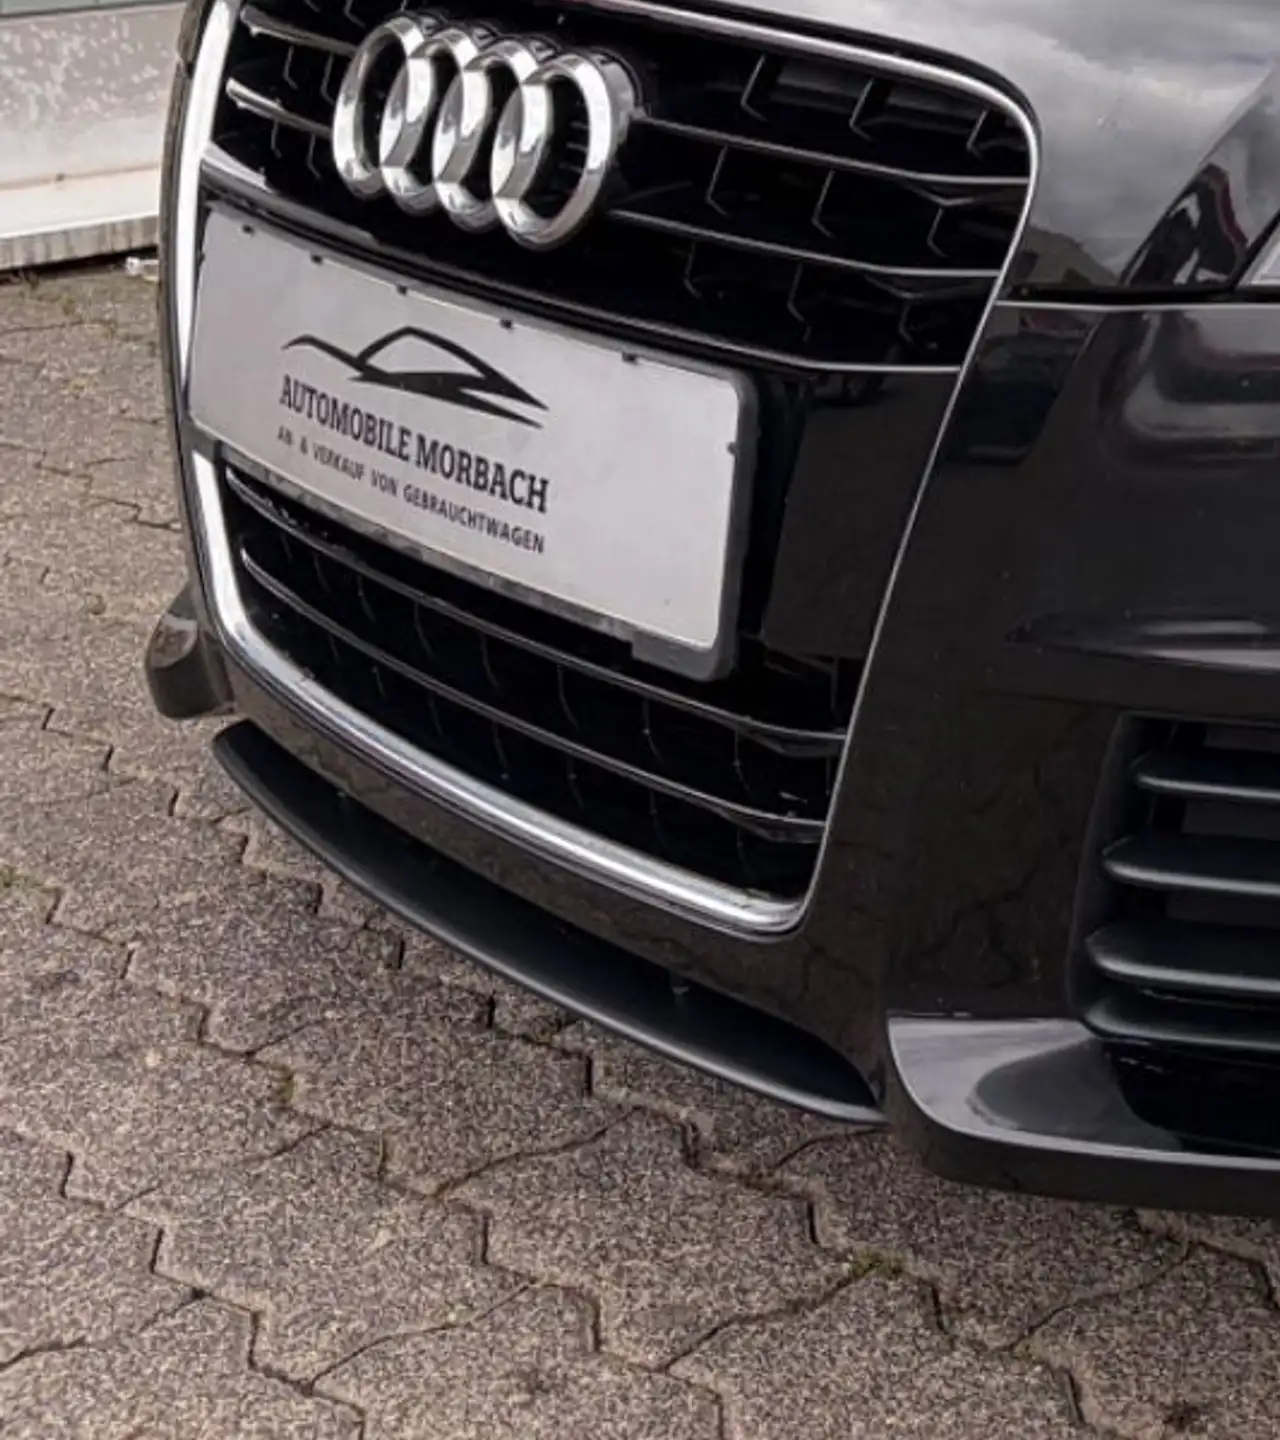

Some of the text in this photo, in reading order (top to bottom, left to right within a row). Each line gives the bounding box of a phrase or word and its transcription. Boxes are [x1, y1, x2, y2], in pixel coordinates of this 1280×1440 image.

[277, 424, 294, 448] AN
[313, 441, 365, 482] VERKAUF
[370, 469, 399, 498] VON
[403, 483, 545, 554] GEBRAUCHTWAGEN
[279, 373, 550, 513] AUTOMOBILE MORBACH
